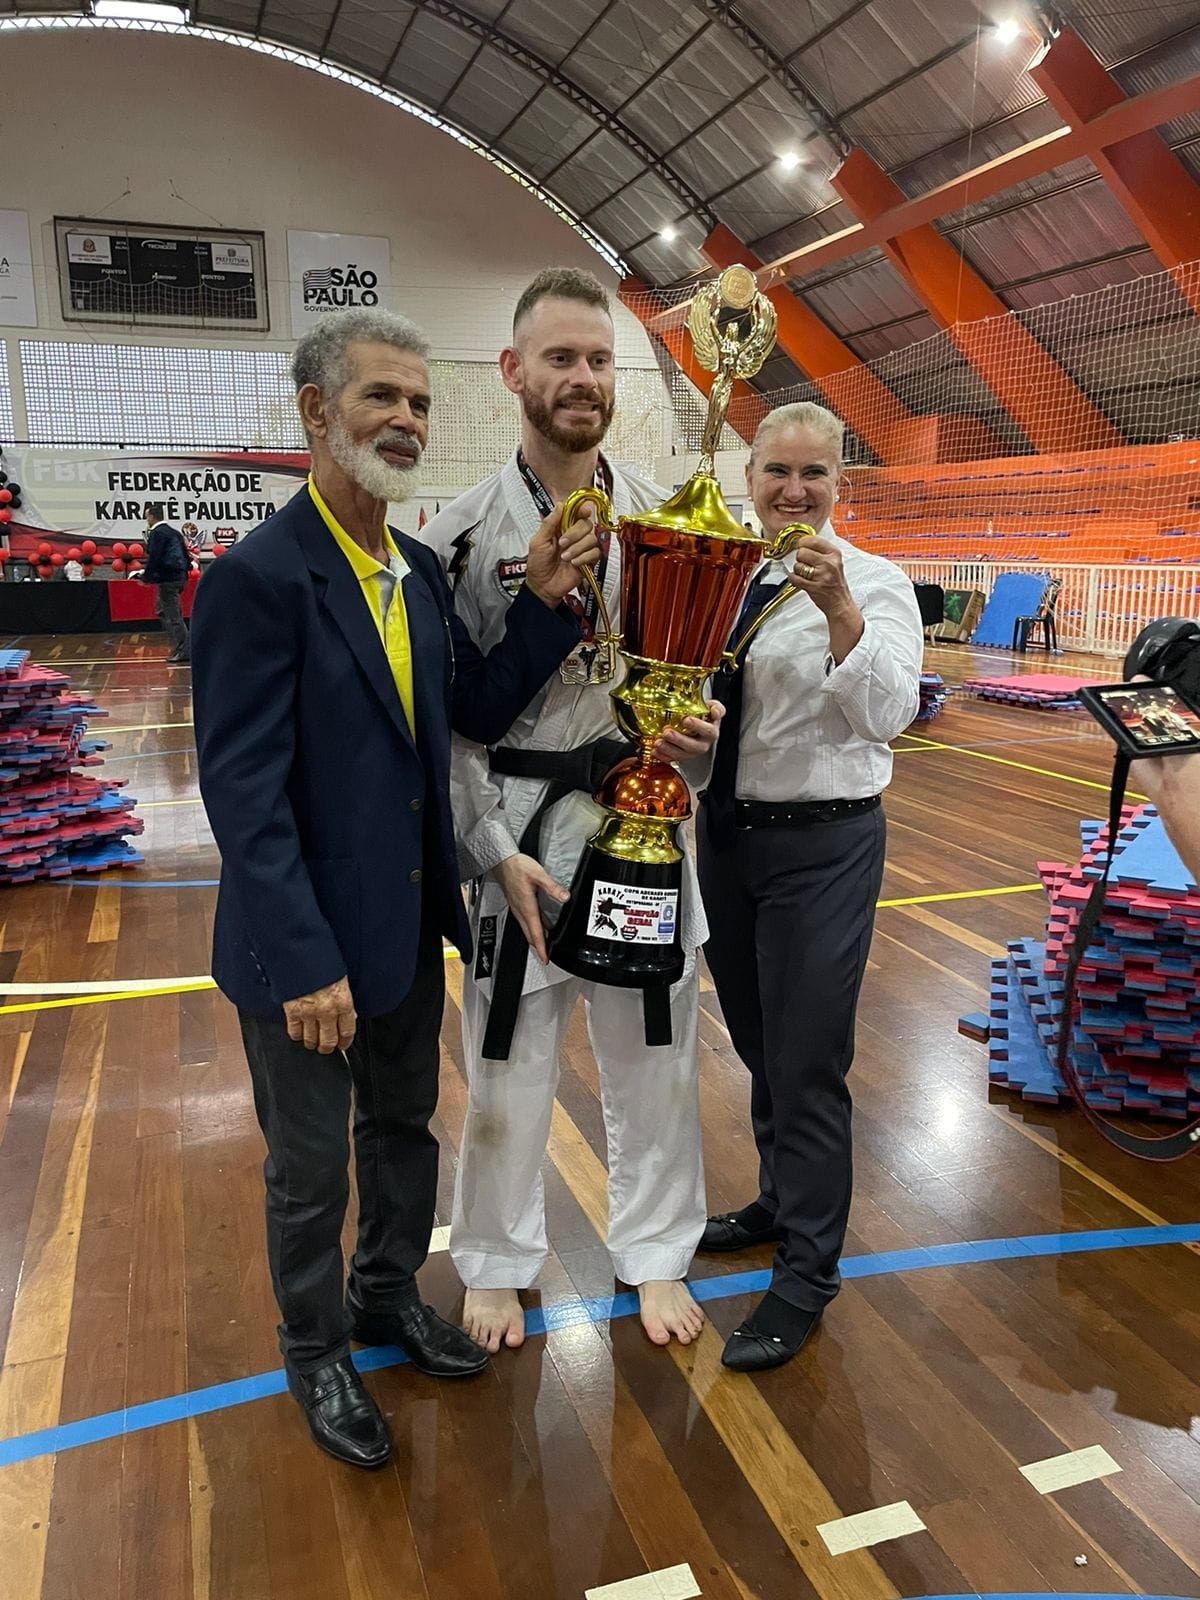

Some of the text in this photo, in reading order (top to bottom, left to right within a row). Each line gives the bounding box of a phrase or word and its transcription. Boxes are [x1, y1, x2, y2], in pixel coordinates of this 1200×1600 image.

[330, 263, 378, 289] SÃO
[303, 287, 379, 307] PAULO
[107, 469, 262, 498] FEDERAÇÃO DE
[184, 501, 277, 520] PAULISTA
